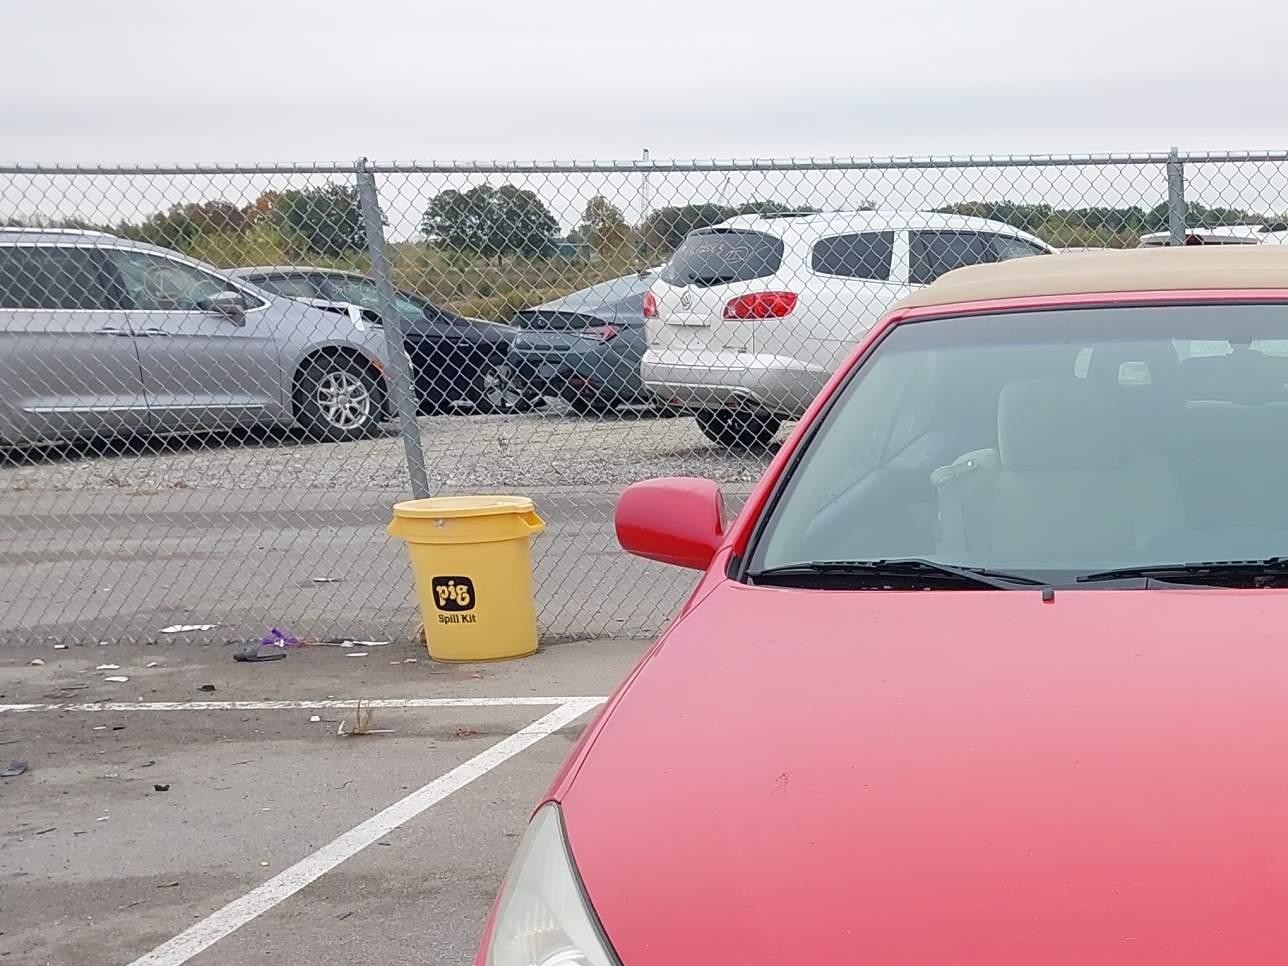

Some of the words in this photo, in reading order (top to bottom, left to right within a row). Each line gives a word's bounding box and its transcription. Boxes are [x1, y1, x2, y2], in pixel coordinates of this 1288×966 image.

[436, 580, 470, 606] pig
[438, 614, 459, 624] Spill
[461, 614, 476, 623] Kit
